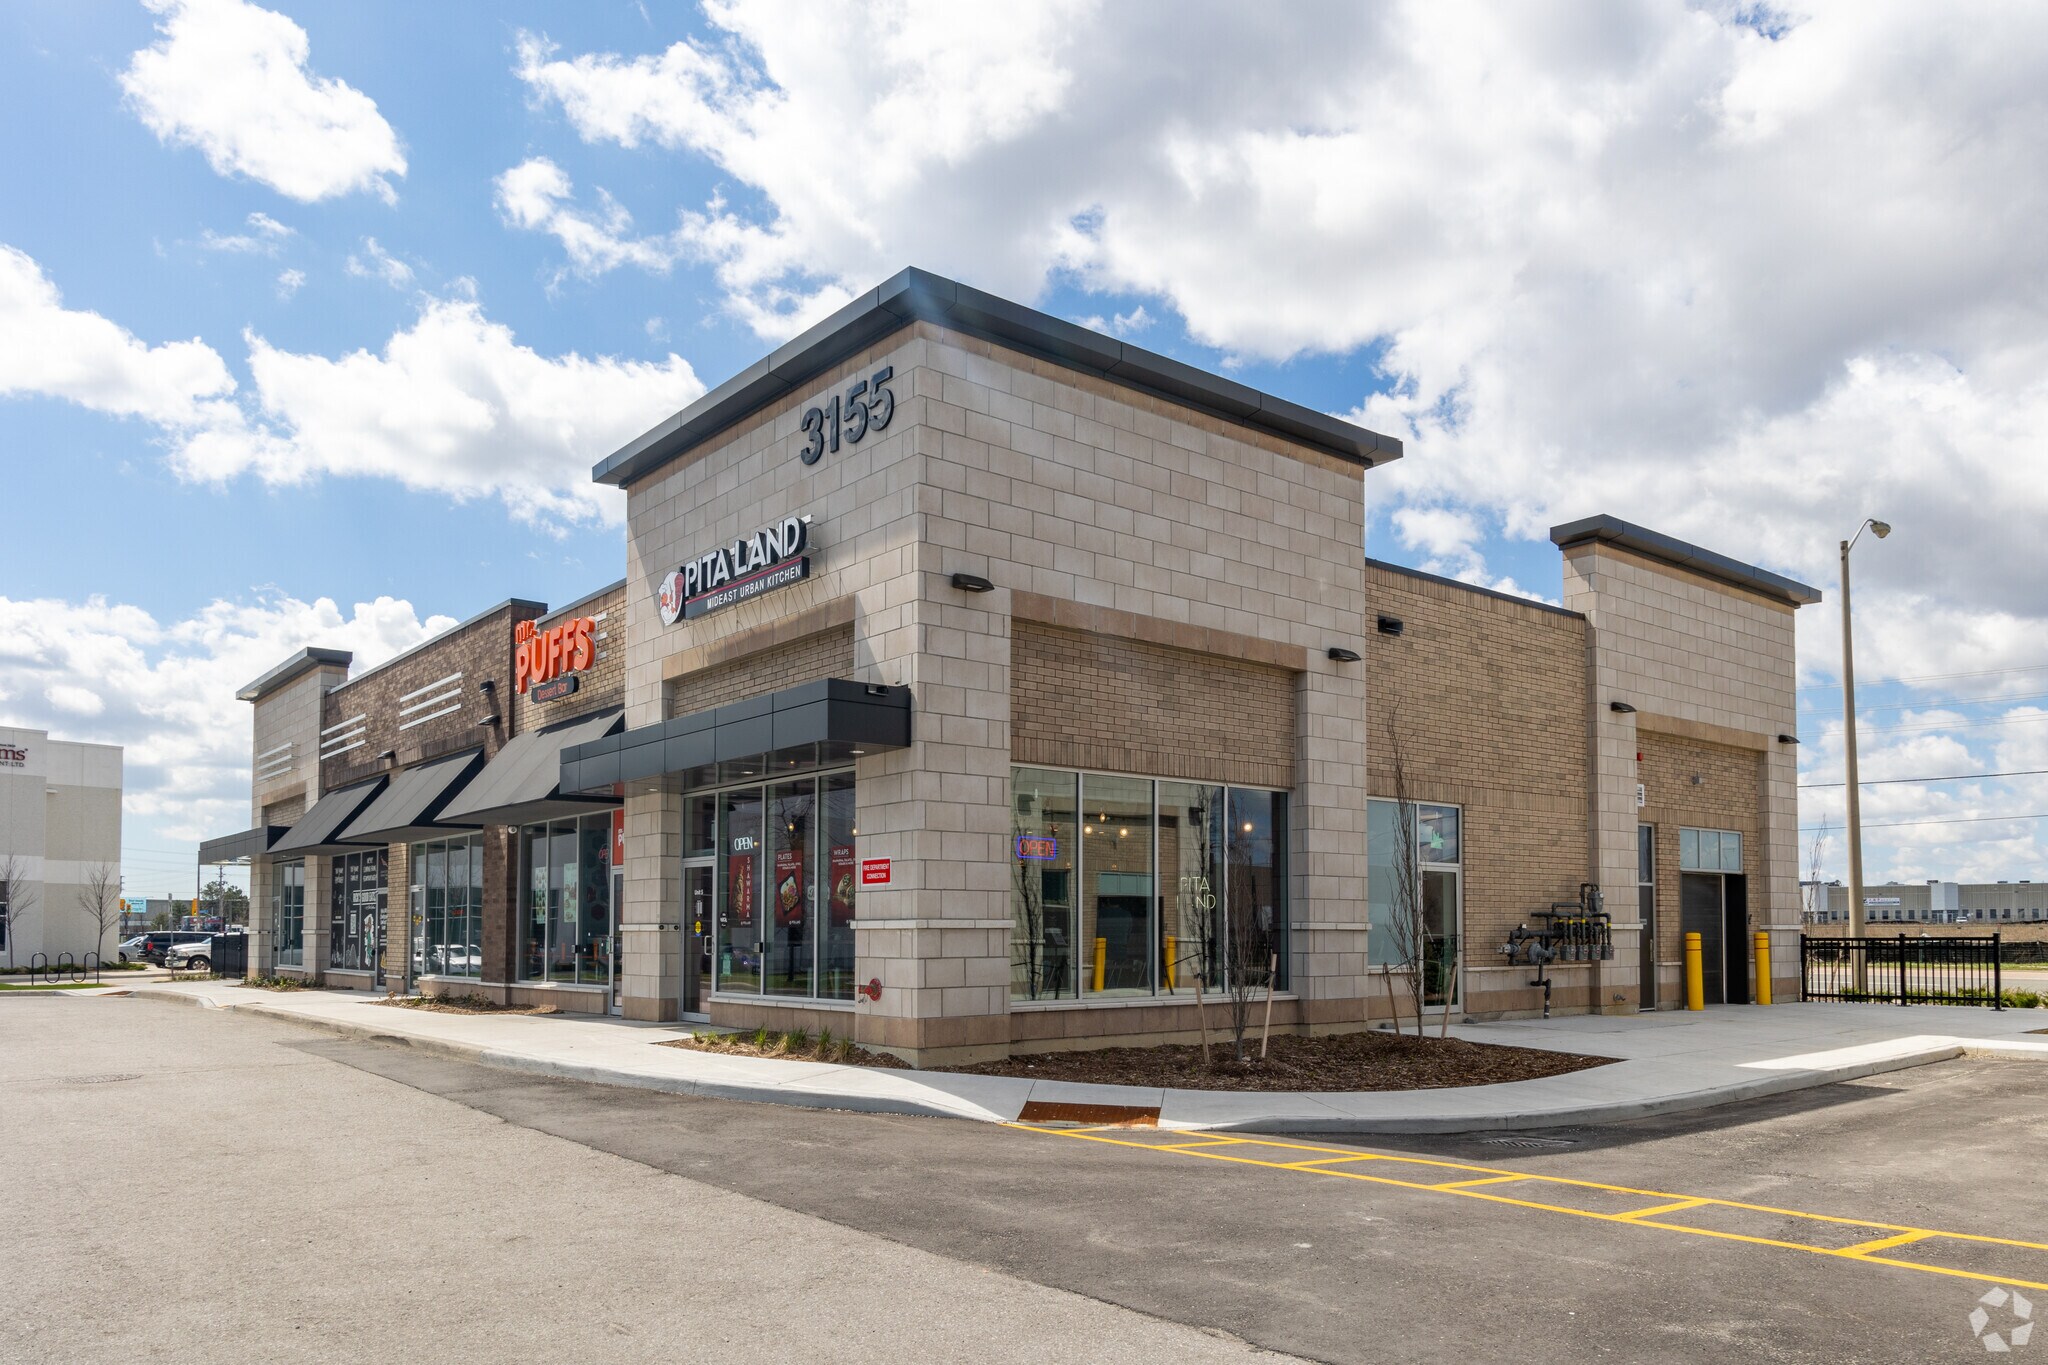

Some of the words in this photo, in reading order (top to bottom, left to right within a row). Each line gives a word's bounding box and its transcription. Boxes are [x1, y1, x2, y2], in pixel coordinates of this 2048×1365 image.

[801, 366, 894, 465] 3155
[684, 548, 731, 597] PITA
[734, 516, 806, 577] LAND
[707, 588, 738, 610] MIDEAST
[740, 577, 765, 598] URBAN
[766, 564, 801, 588] KITCHEN
[516, 617, 595, 695] PUFFS
[537, 684, 556, 701] Dessert
[557, 682, 568, 695] Bar
[734, 836, 753, 851] OPEN
[834, 848, 849, 856] WRAPS
[1019, 839, 1055, 857] OPEN
[777, 853, 792, 861] PLATES
[866, 872, 887, 880] CONNECTION
